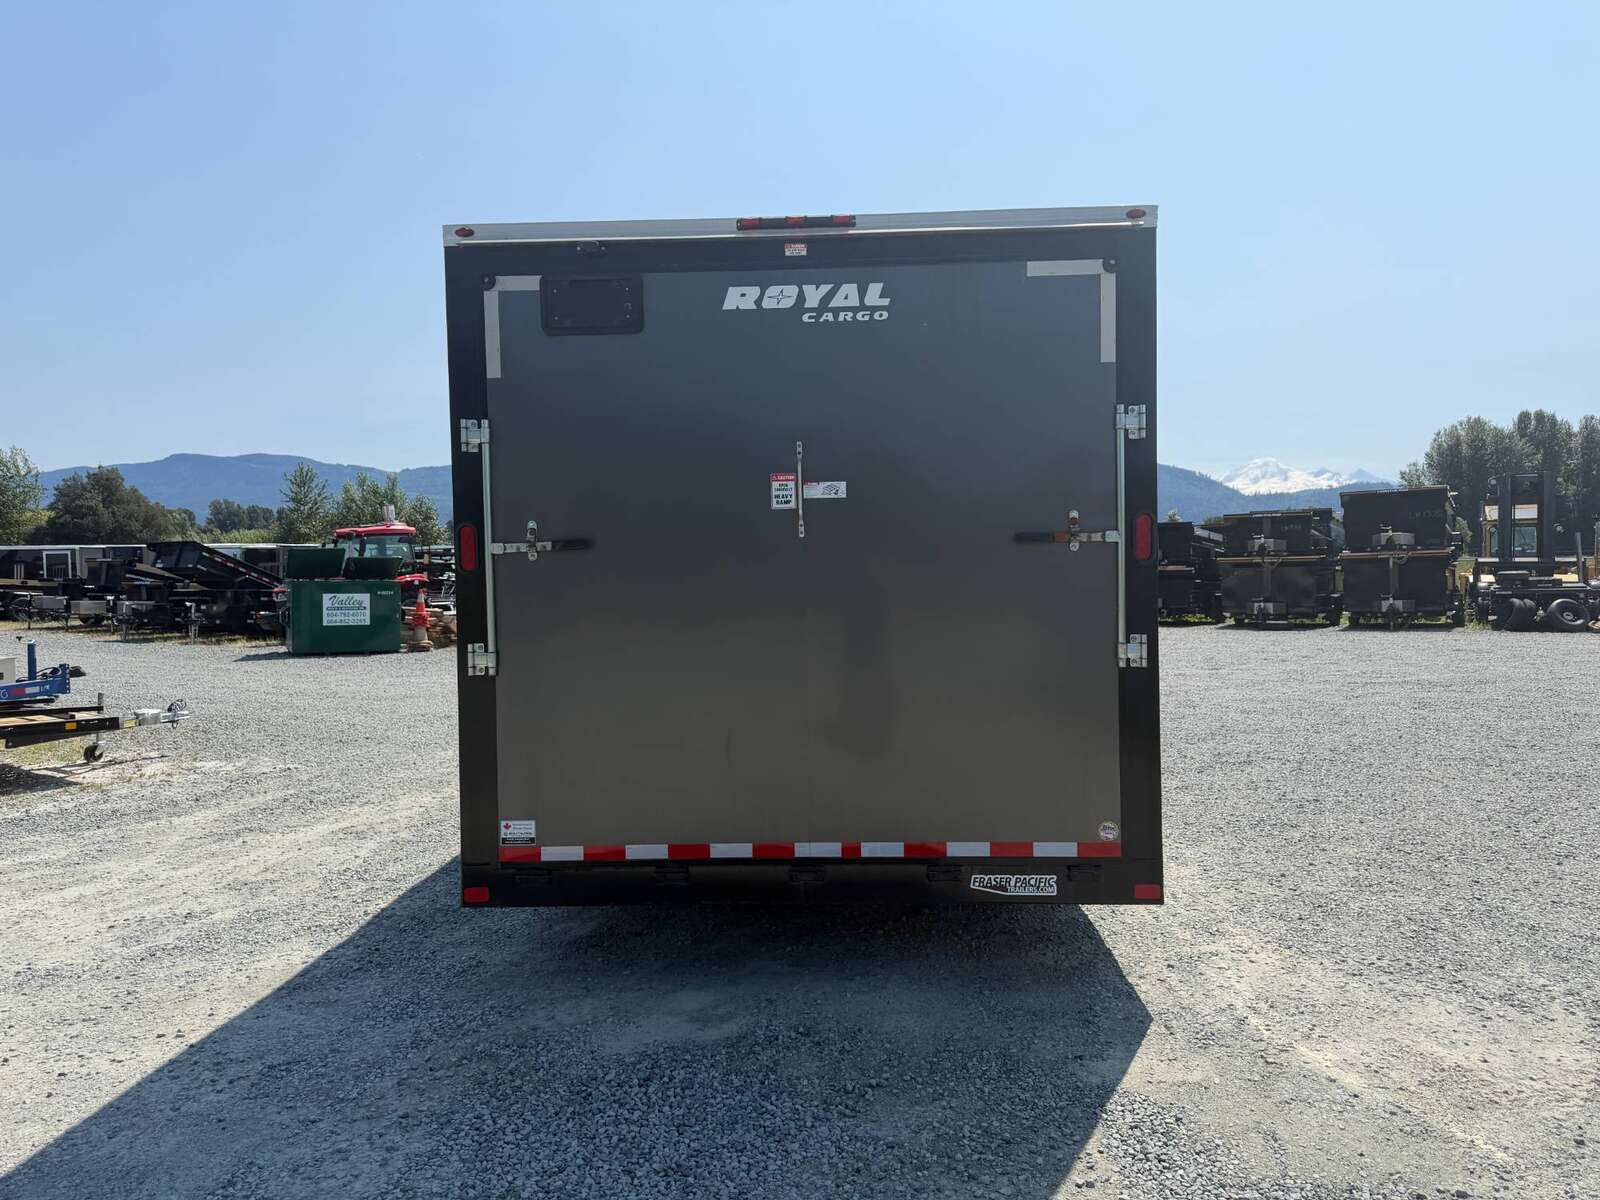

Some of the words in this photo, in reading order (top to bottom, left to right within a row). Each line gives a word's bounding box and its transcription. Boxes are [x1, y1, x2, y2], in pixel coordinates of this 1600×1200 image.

[722, 282, 891, 310] ROYAL
[802, 311, 889, 323] CARGO
[329, 595, 364, 606] Valley
[972, 876, 1011, 887] FRASER
[1014, 876, 1056, 887] PACIFIC
